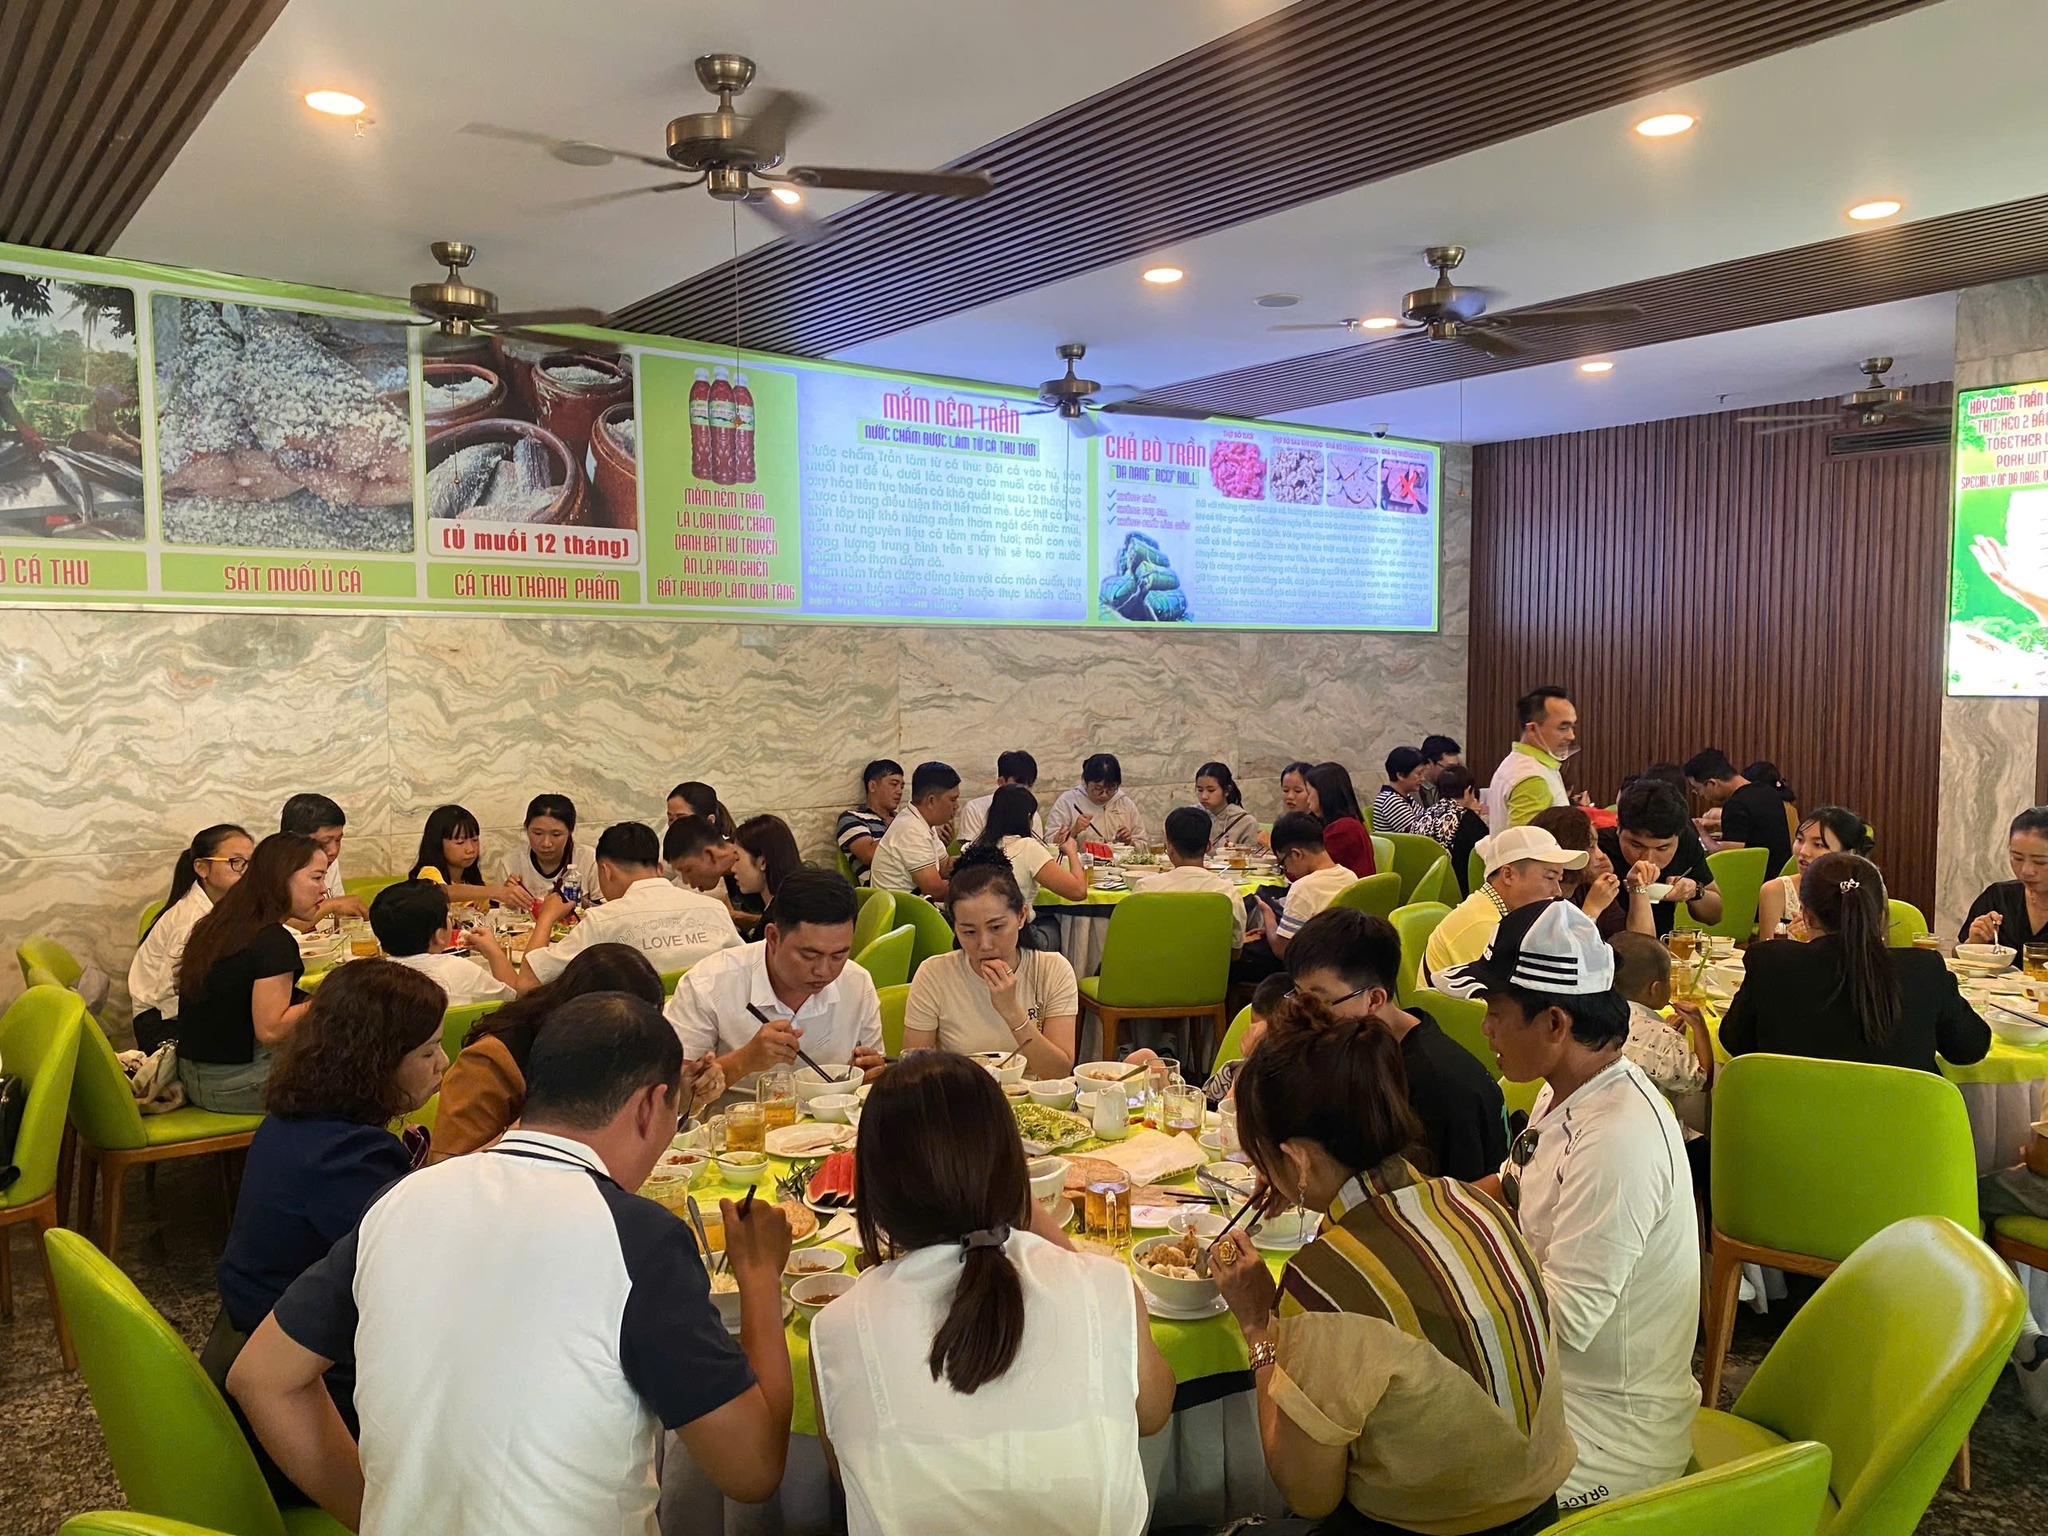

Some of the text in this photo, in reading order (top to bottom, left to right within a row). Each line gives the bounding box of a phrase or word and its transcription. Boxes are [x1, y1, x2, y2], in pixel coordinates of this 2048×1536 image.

[883, 387, 1020, 434] MẮM NÊM TRẦN
[1969, 388, 2043, 415] HÃY CÙNG TRẦN
[2001, 415, 2020, 431] HEO
[2022, 414, 2029, 429] 2
[1105, 431, 1206, 467] CHẢ BÒ TRẦN
[1987, 433, 2042, 451] TOGETHER
[1996, 453, 2025, 468] PORK
[684, 483, 764, 510] MẮM NÊM TRẦN
[677, 508, 775, 533] LÀ LOẠI NƯỚC CHẤM
[443, 524, 629, 559] (Ủ muối 12 tháng)
[675, 531, 778, 555] DANH BẤT HƯ TRUYỀN
[14, 553, 42, 584] CÁ
[50, 559, 89, 586] THU
[224, 560, 361, 593] SÁT MUỐI Ủ CÁ
[684, 555, 768, 577] ĂN LÀ PHẢI GHIỀN
[454, 569, 620, 600] CÁ THU THÀNH PHẨM
[657, 574, 677, 596] RẤT
[680, 578, 699, 597] PHÙ
[702, 580, 722, 599] HỢP
[725, 579, 747, 599] LÀM
[750, 581, 768, 600] QUÀ
[771, 582, 795, 602] TẶNG
[642, 934, 683, 950] LOVE
[686, 932, 709, 945] ME
[1560, 1485, 1609, 1508] GRACE
